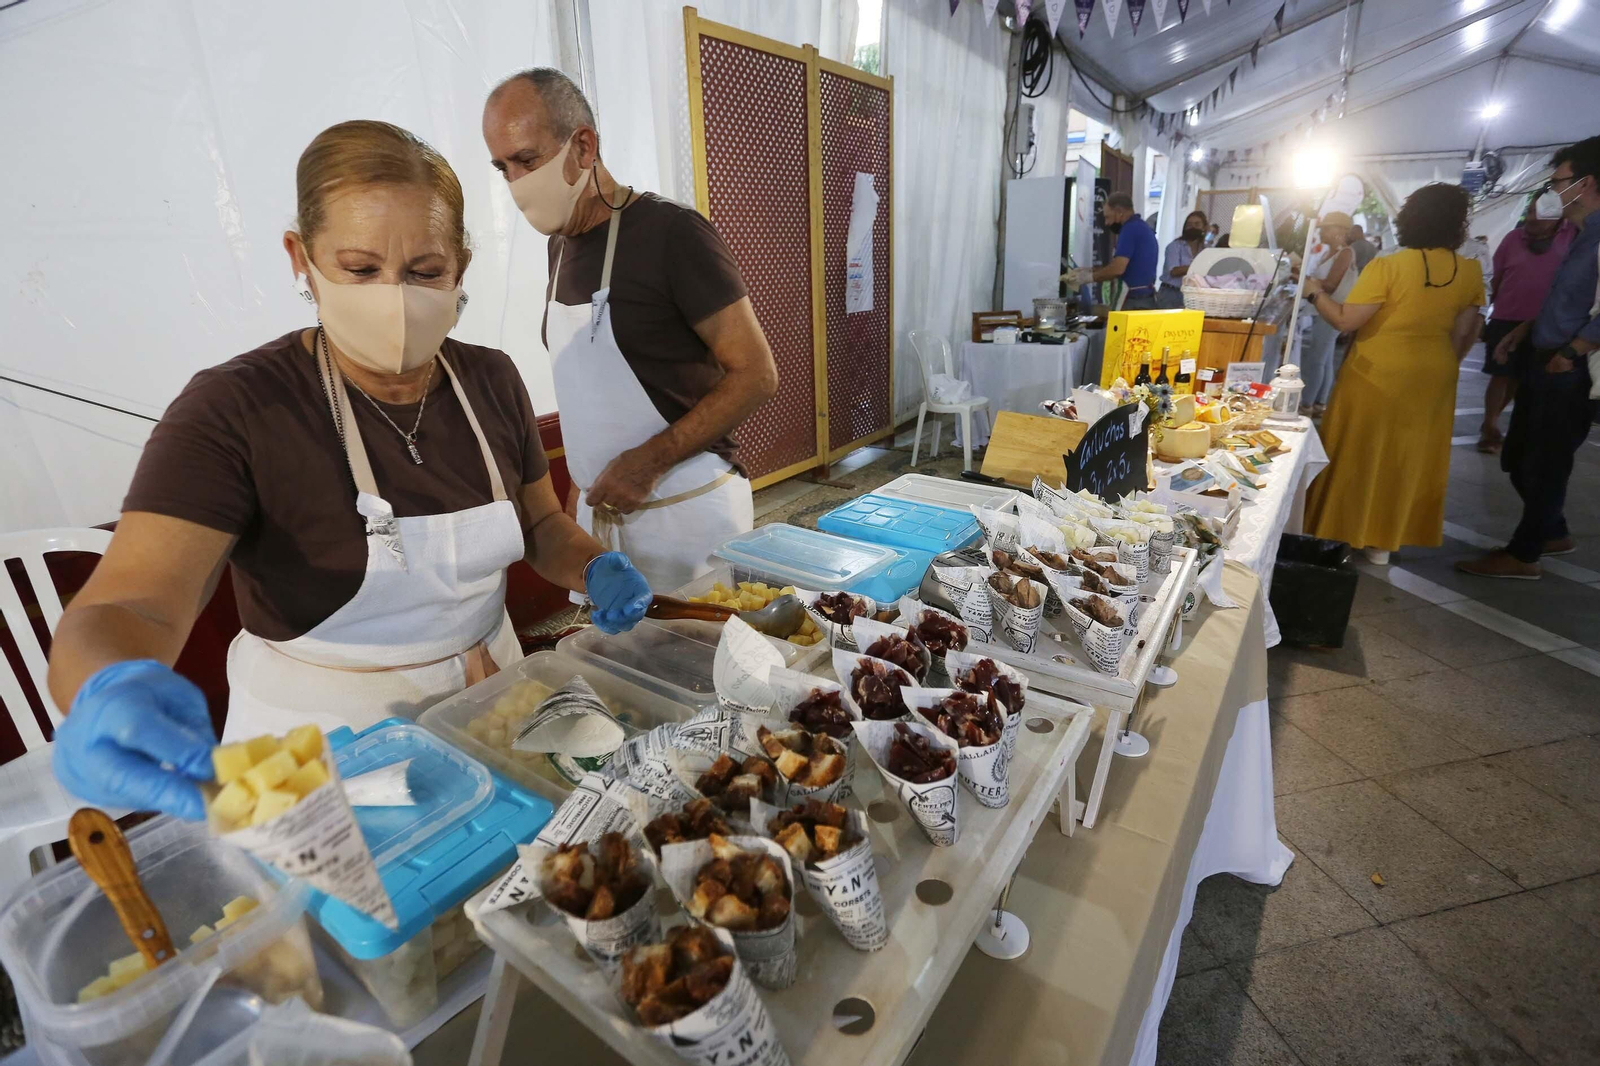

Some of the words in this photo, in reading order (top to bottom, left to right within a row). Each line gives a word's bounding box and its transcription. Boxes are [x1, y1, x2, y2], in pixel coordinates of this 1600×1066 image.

[488, 863, 523, 906] CORSETS
[509, 886, 525, 903] N
[825, 885, 837, 897] Y
[851, 875, 862, 892] N
[833, 889, 872, 909] CORSETS
[739, 1030, 754, 1054] N
